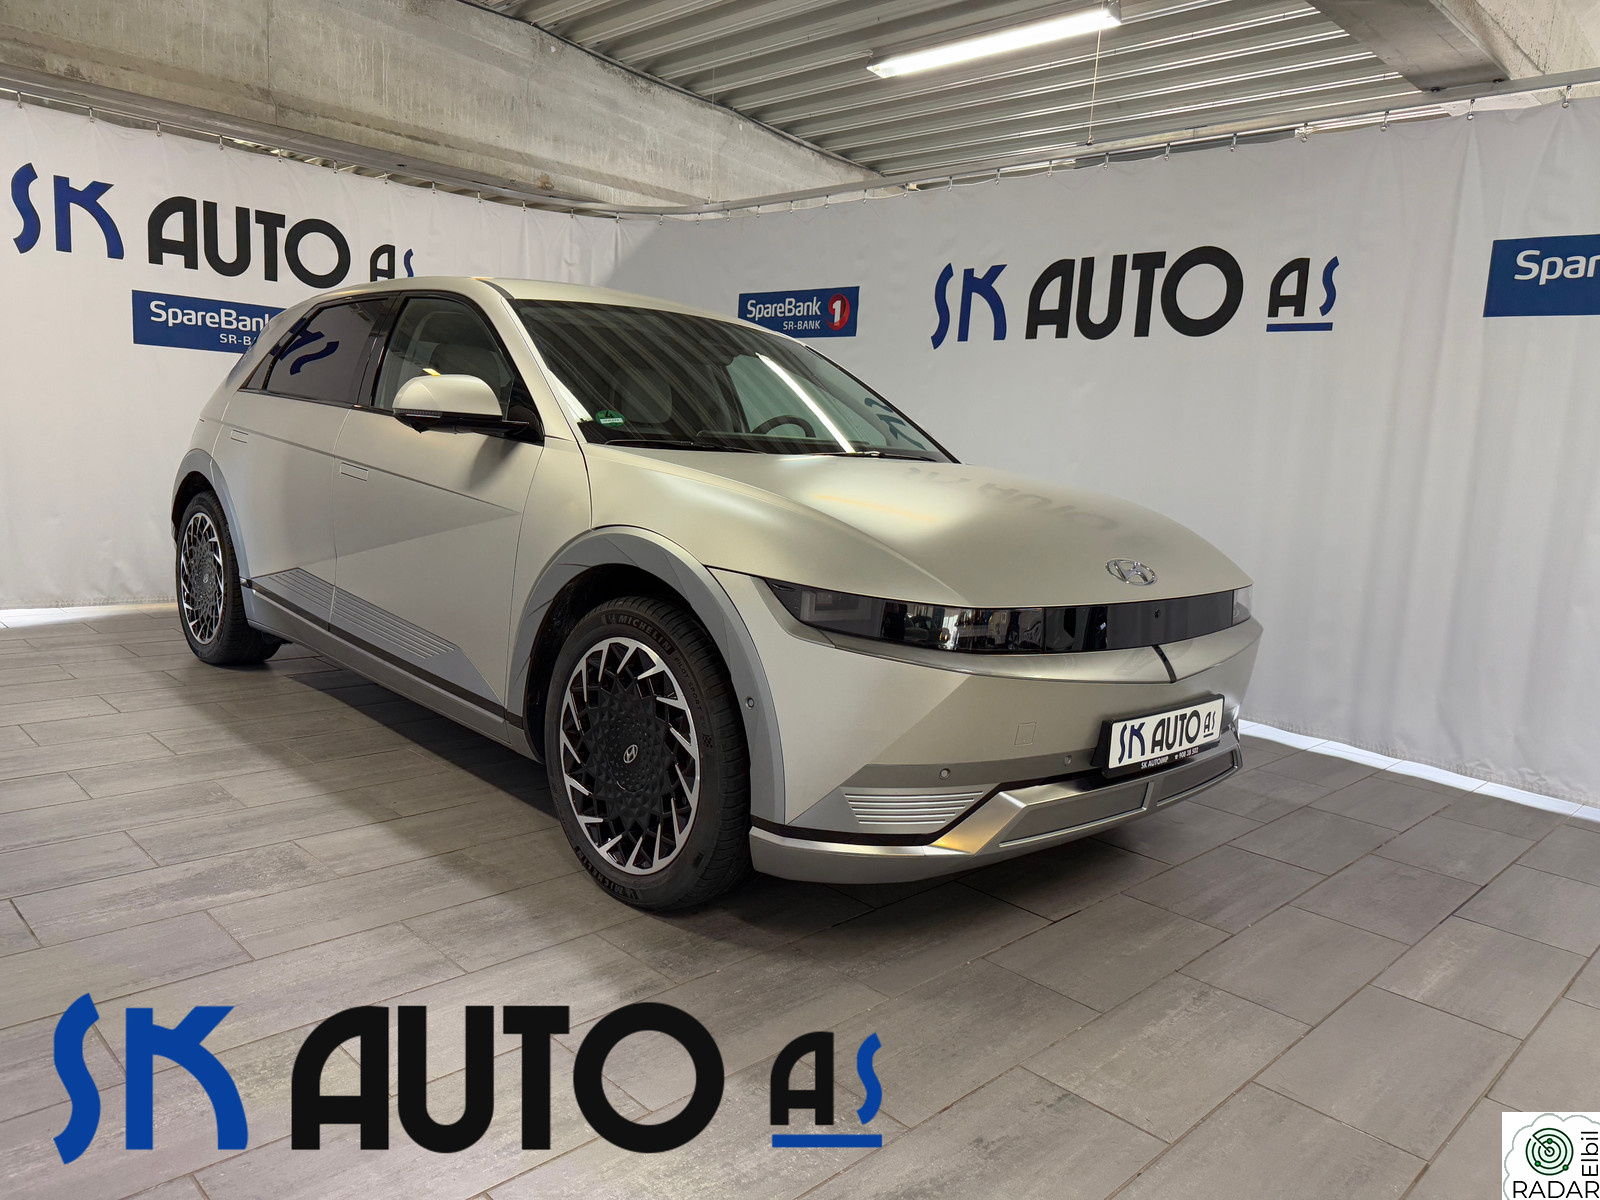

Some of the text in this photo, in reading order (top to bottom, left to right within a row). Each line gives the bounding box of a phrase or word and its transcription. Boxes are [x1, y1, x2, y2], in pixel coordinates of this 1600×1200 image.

[11, 163, 124, 260] SK
[148, 196, 351, 289] AUTO
[746, 296, 822, 321] SpareBank
[931, 246, 1339, 350] SK AUTO AS
[220, 333, 257, 346] SR-B
[783, 320, 821, 331] SR-BANK
[618, 614, 672, 655] MICHELIN
[674, 656, 690, 680] PILOT
[687, 682, 703, 712] SPORT
[1118, 710, 1216, 764] SK AUTO AS
[1141, 761, 1148, 769] SK
